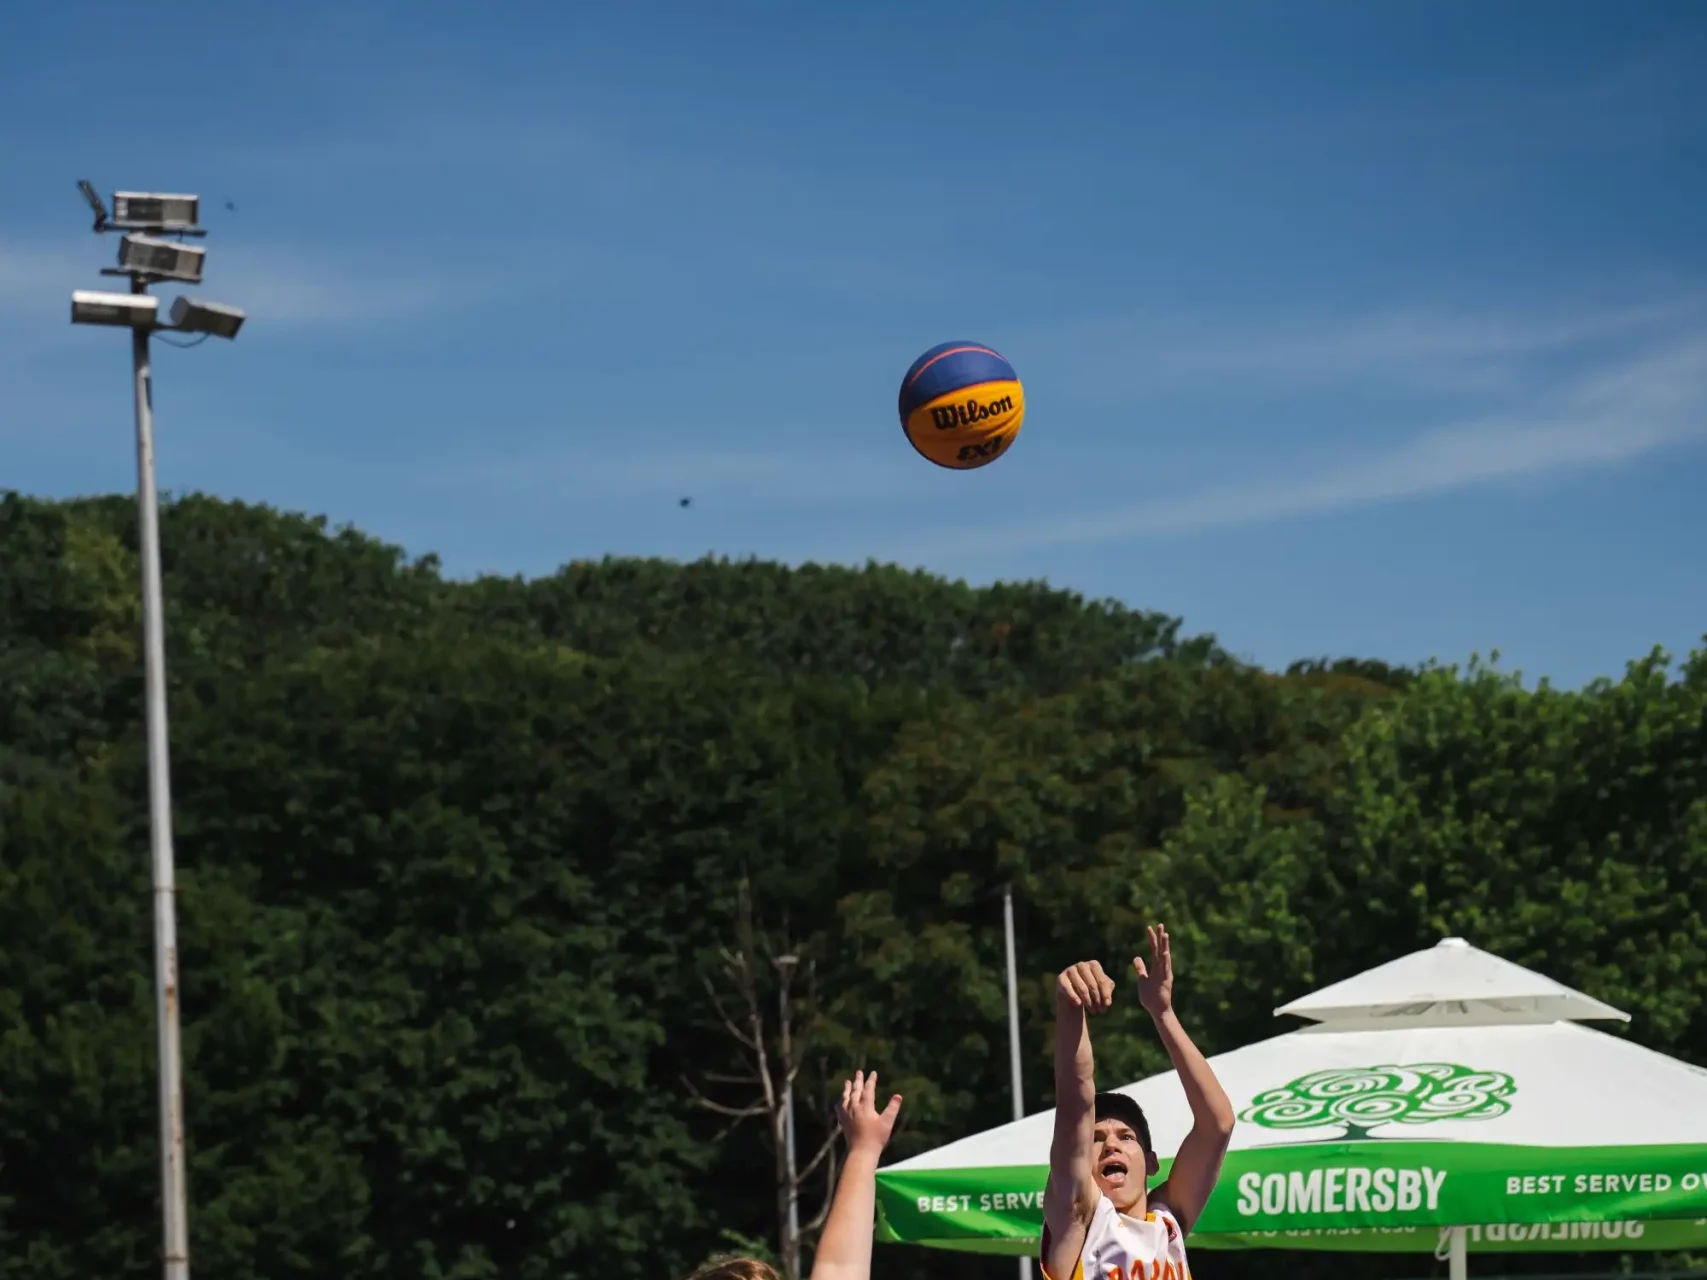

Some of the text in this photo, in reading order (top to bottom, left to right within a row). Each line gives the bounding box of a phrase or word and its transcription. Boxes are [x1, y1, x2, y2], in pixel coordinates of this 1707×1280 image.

[930, 395, 1013, 429] Wilson
[1236, 1166, 1448, 1216] SOMERSBY
[1506, 1175, 1566, 1194] BEST
[1574, 1173, 1672, 1193] SERVED
[917, 1190, 1044, 1213] BEST SERVE
